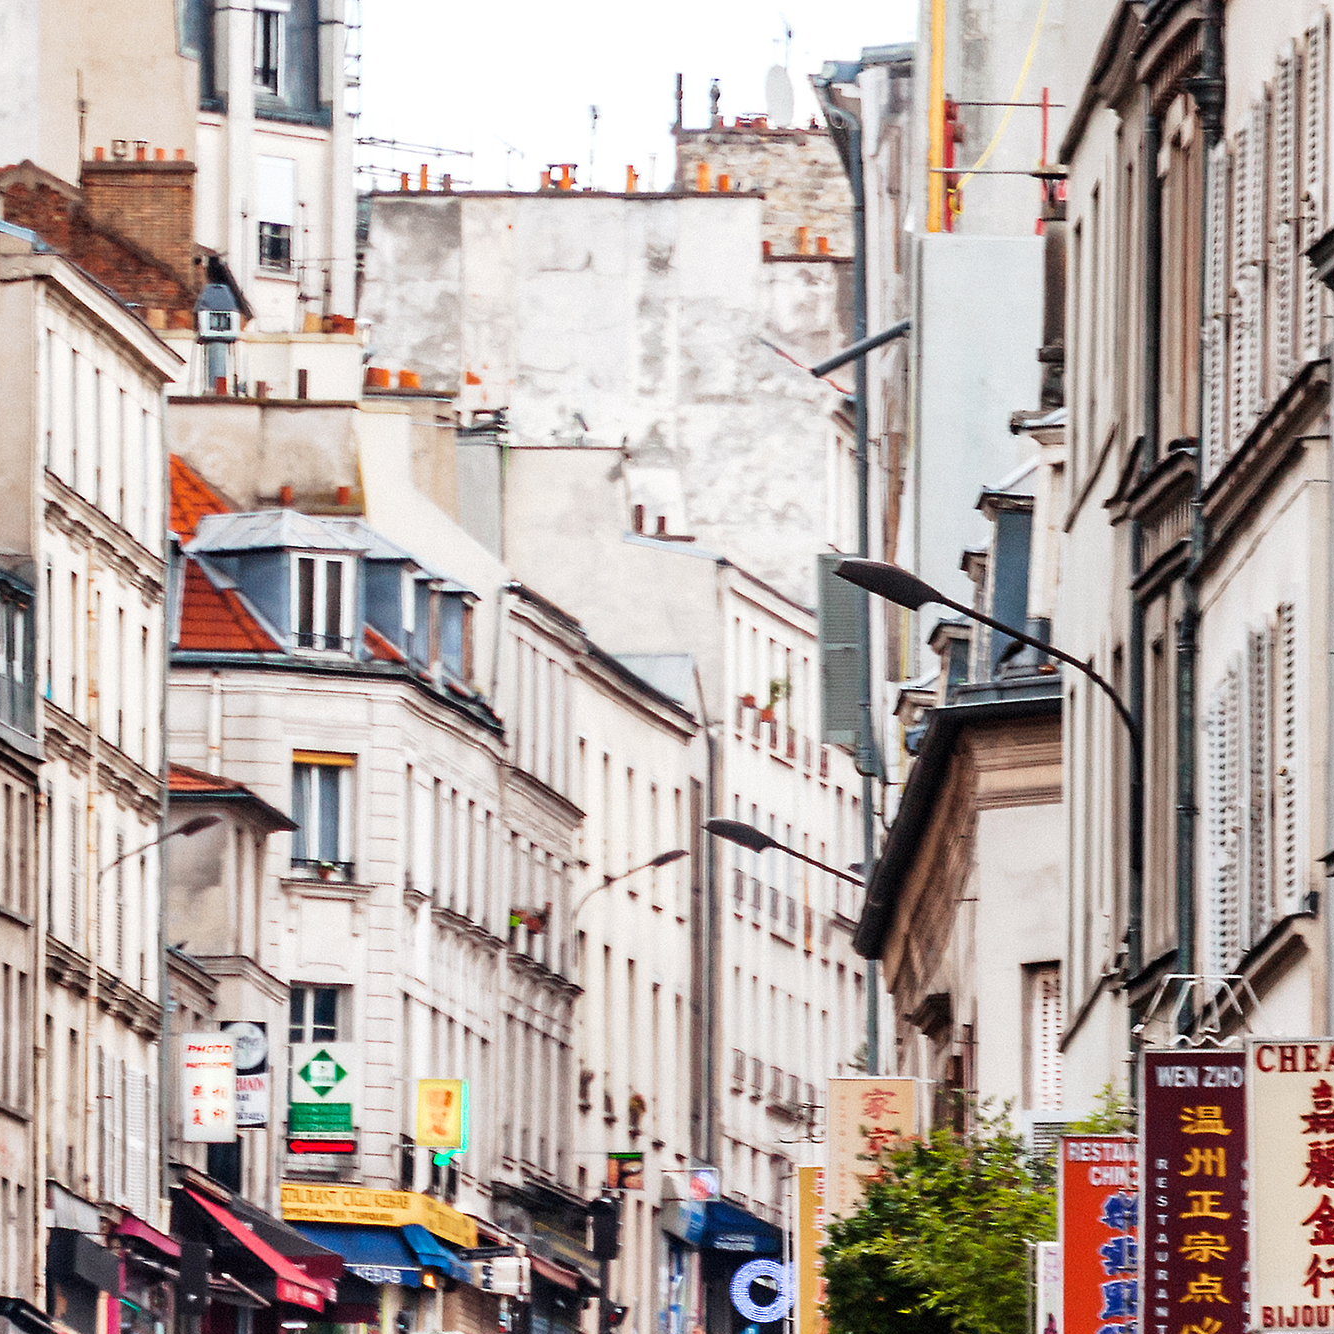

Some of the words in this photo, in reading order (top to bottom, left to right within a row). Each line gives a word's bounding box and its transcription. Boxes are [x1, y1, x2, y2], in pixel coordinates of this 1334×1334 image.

[186, 1045, 233, 1055] PHOTO
[1154, 1066, 1198, 1088] WEN
[1201, 1066, 1245, 1088] ZHO
